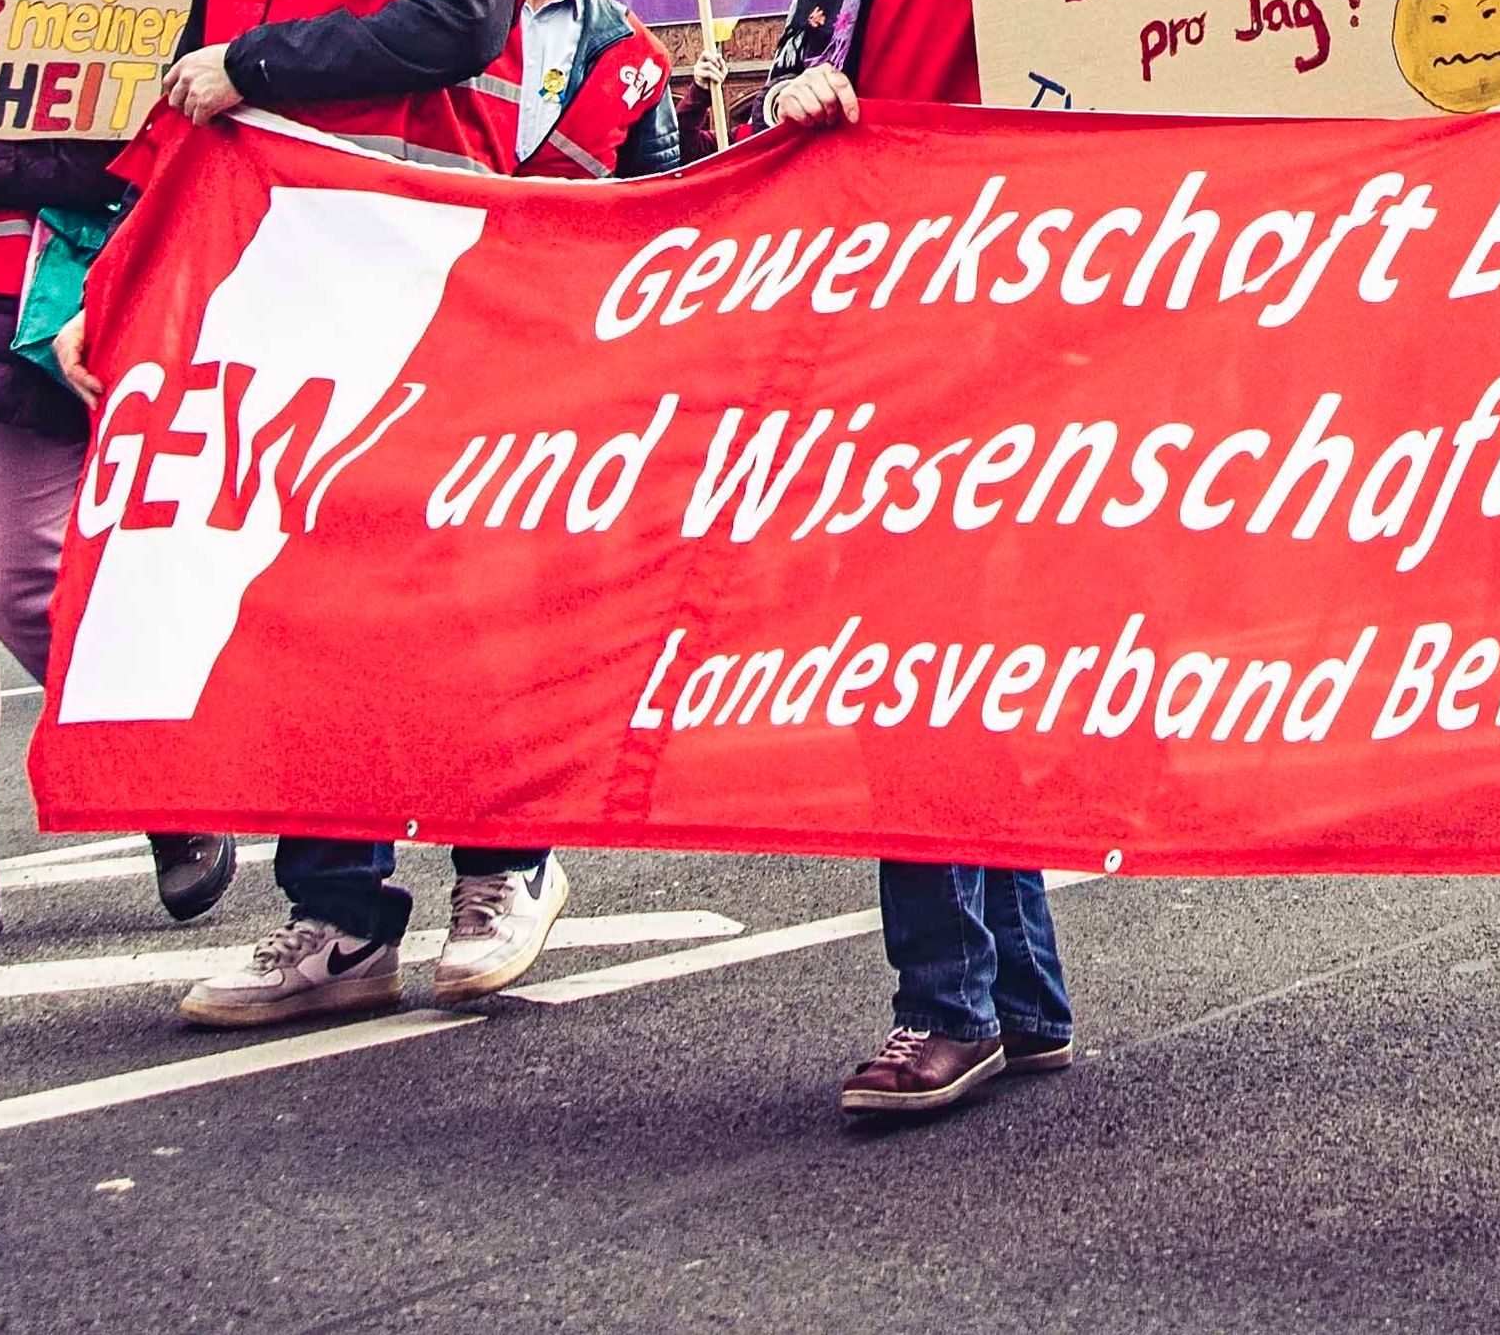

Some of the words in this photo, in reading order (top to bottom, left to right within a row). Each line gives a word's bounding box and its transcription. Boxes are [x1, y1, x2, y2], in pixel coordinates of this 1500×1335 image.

[619, 64, 655, 102] GEW
[1140, 13, 1207, 82] pro
[595, 170, 1438, 342] Gewerkschaft
[77, 360, 427, 540] GEW
[425, 393, 680, 533] und
[629, 615, 1379, 743] Landesverband
